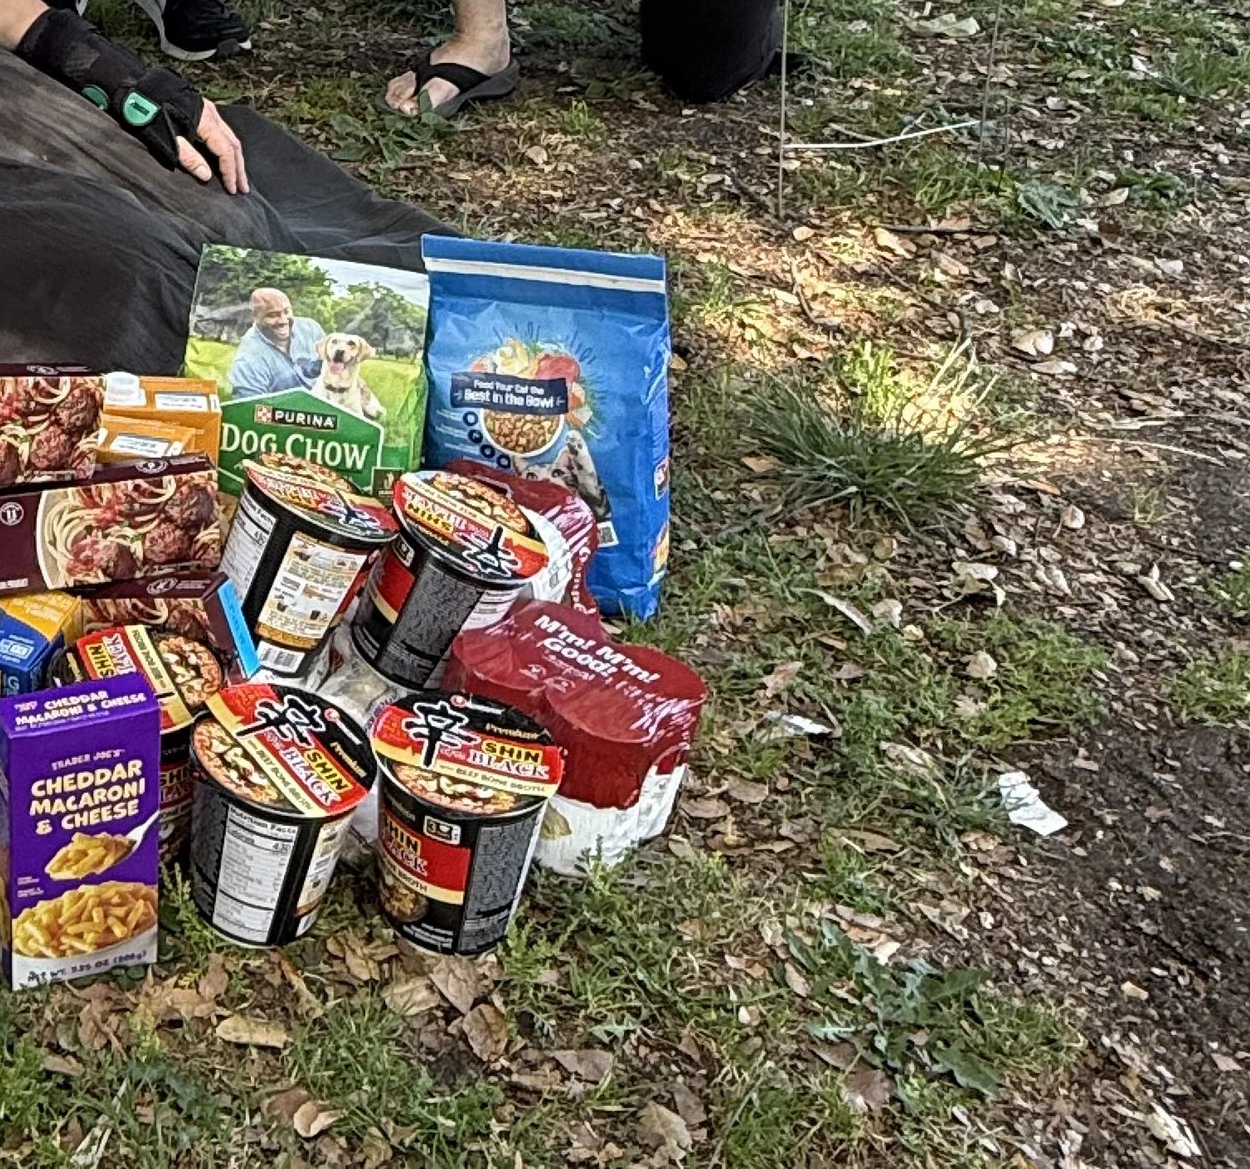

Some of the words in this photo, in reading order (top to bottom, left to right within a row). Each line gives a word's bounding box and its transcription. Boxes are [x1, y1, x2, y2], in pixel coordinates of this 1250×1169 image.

[464, 388, 491, 401] Best
[492, 391, 504, 404] in
[505, 392, 524, 406] the
[526, 395, 554, 409] Bowl
[274, 410, 335, 428] PURINA
[220, 422, 278, 455] DOG
[285, 433, 371, 470] CHOW
[90, 644, 114, 677] SHIN
[542, 637, 619, 678] Good!
[15, 705, 84, 726] MACARONI
[100, 692, 147, 709] CHEESE
[44, 690, 109, 711] CHEDDAR
[402, 700, 482, 770] 辛
[483, 741, 541, 764] SHIN
[51, 754, 91, 771] TRADER
[93, 749, 121, 761] JOE'S
[279, 746, 342, 806] BLACK
[306, 749, 349, 792] SHIN
[466, 749, 550, 779] BLACK
[31, 759, 143, 797] CHEDDAR
[29, 777, 146, 816] MACARONI
[35, 818, 53, 835] &
[61, 799, 140, 830] CHEESE
